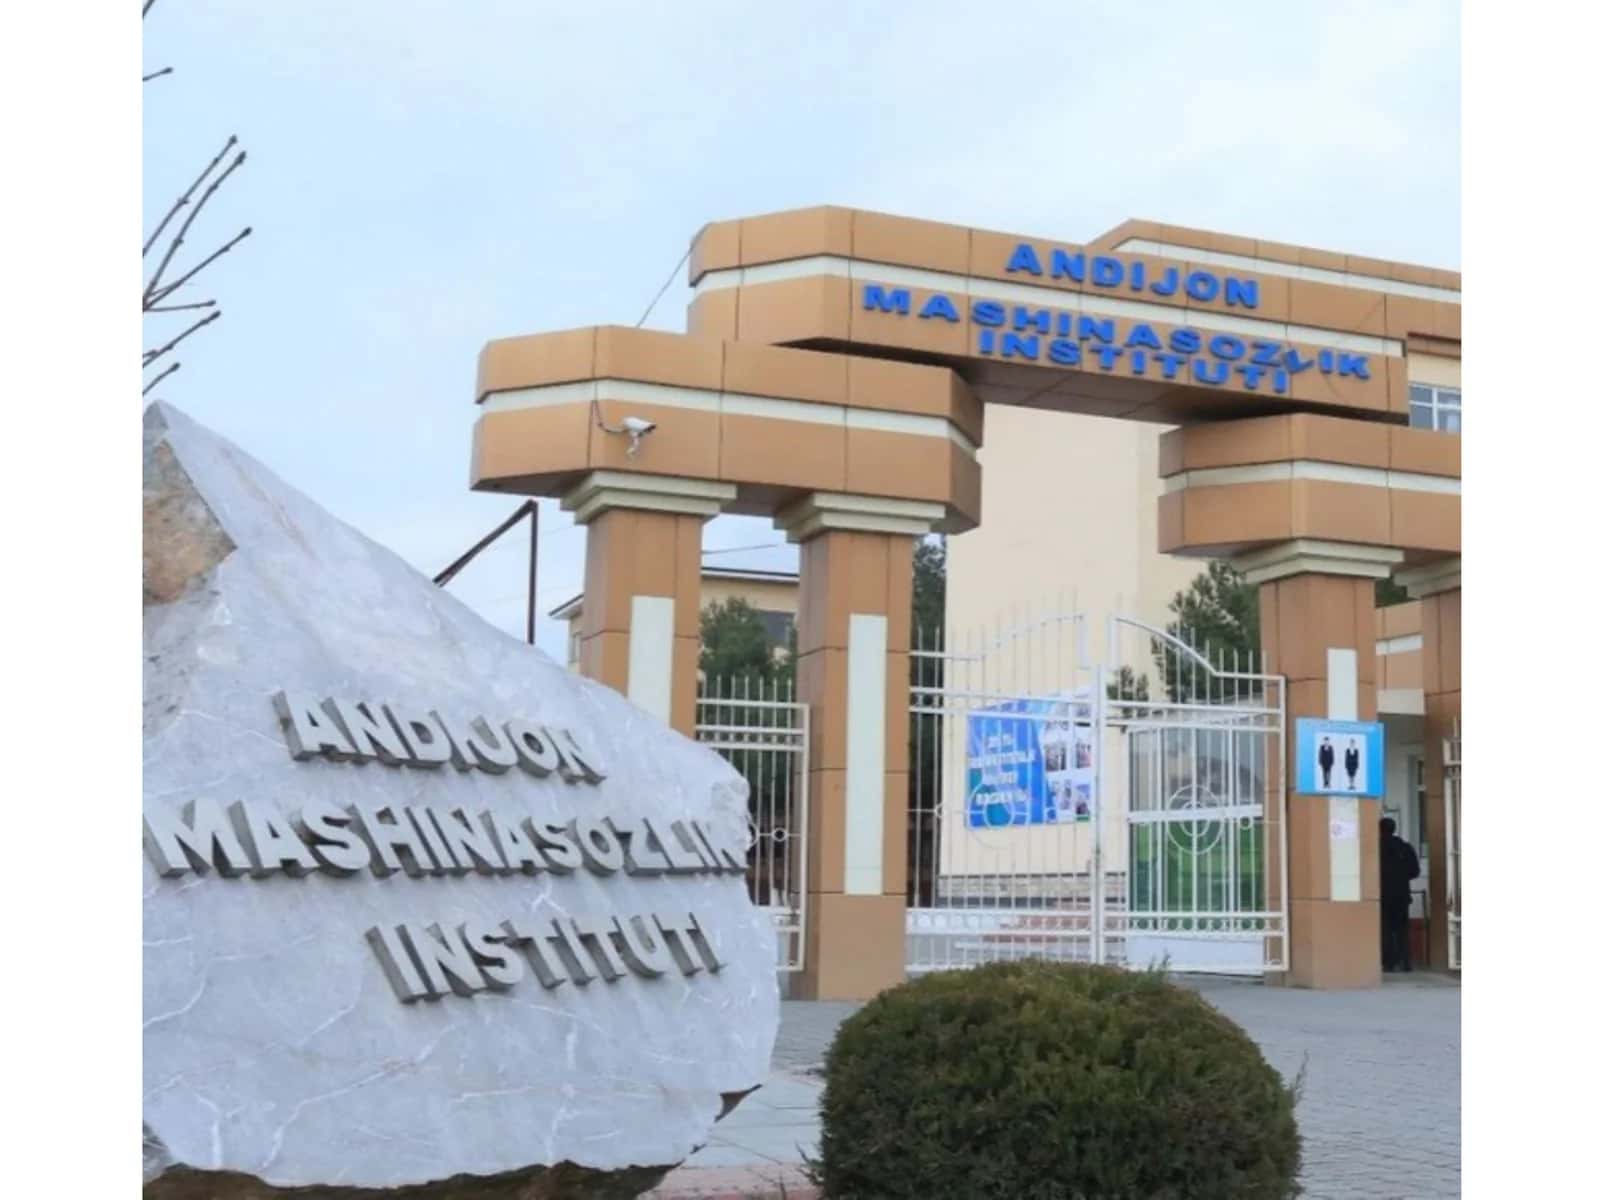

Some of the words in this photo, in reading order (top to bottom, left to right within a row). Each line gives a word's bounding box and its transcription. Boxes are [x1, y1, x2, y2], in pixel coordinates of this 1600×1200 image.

[1006, 243, 1260, 309] ANDIJON
[862, 285, 1371, 380] MASHINASOZLIK
[978, 329, 1291, 394] INSTITUTI
[271, 690, 606, 785] ANDIJON
[142, 799, 748, 878] MASHINASOZLIK
[365, 911, 725, 1003] INSTITUTI
